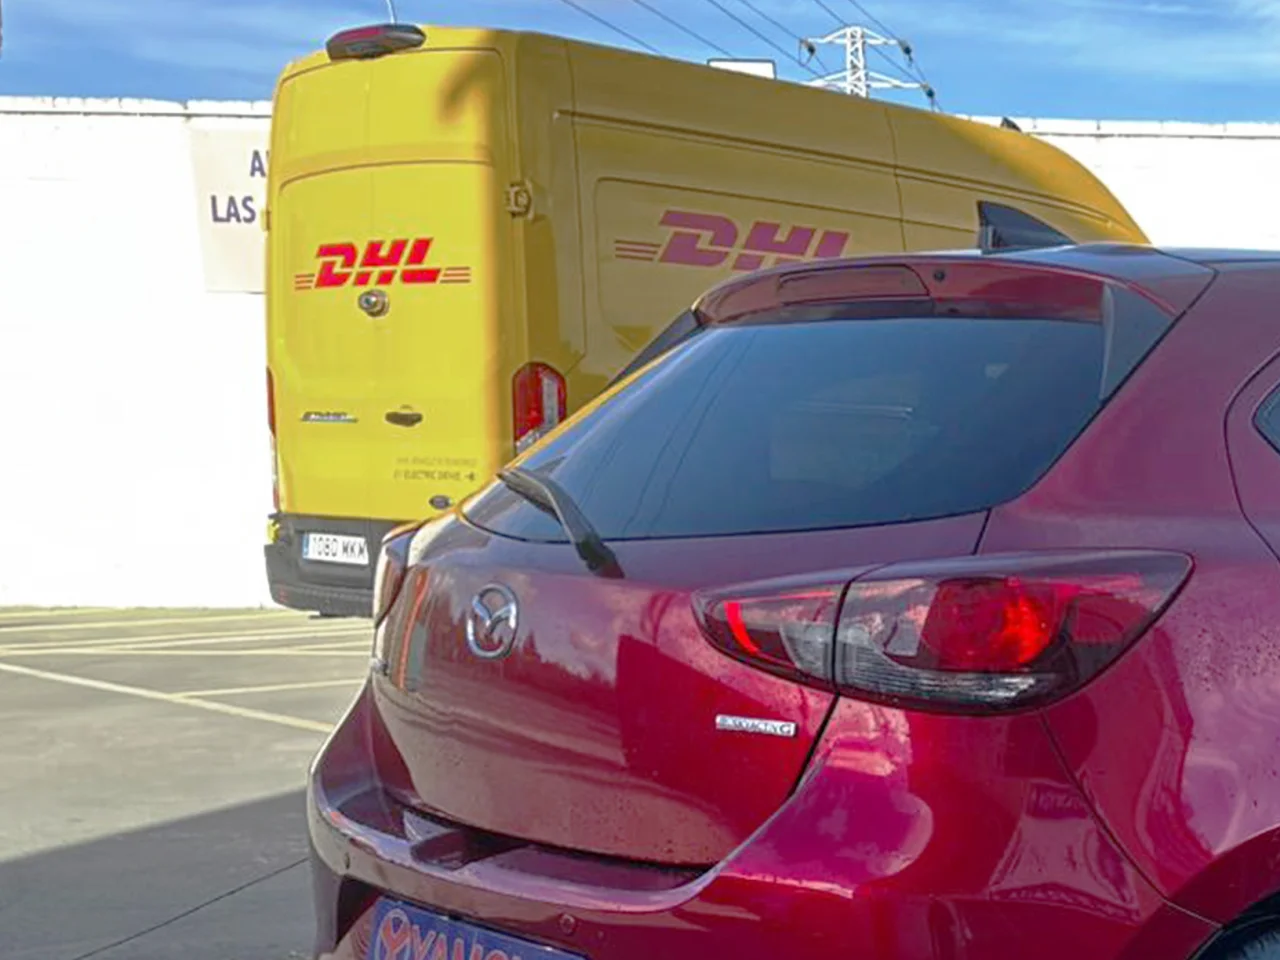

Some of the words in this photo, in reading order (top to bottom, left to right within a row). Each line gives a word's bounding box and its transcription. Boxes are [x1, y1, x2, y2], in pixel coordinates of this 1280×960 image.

[250, 149, 269, 177] A
[211, 195, 256, 223] LAS
[314, 237, 442, 289] DHL
